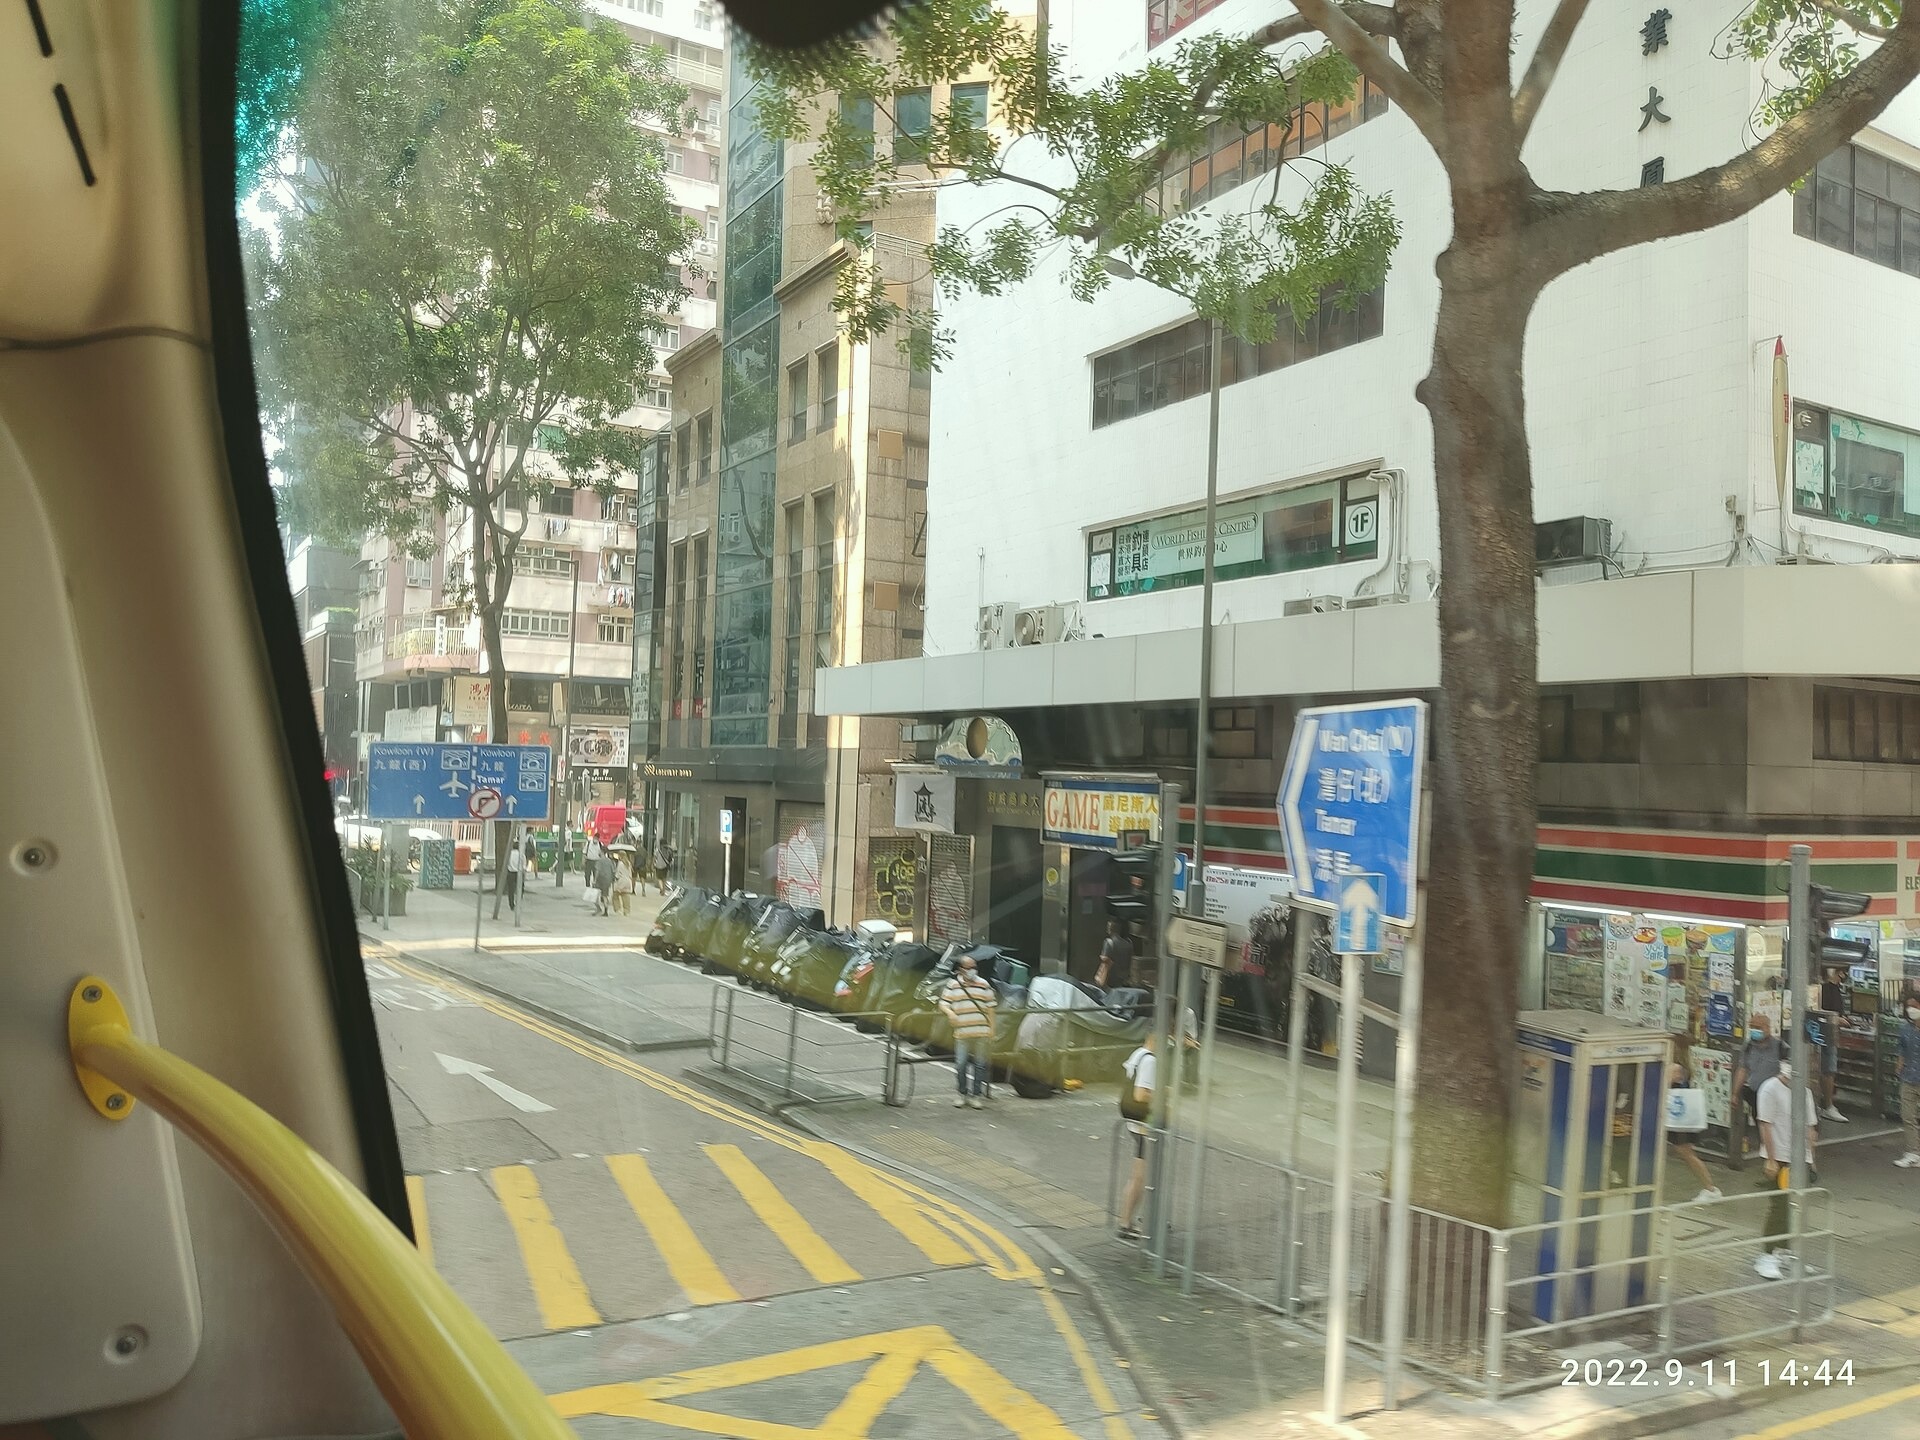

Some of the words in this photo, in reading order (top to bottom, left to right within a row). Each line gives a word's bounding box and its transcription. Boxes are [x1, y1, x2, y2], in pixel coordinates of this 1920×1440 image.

[1352, 512, 1370, 534] 1F
[1319, 728, 1350, 753] Wan
[1350, 727, 1383, 753] Chai
[374, 746, 414, 757] Kowloon
[480, 748, 517, 759] Kowloon
[476, 774, 506, 786] Tamar
[1047, 791, 1100, 832] GAME
[1102, 794, 1160, 815] 威尼斯人
[1314, 807, 1358, 837] Tamar
